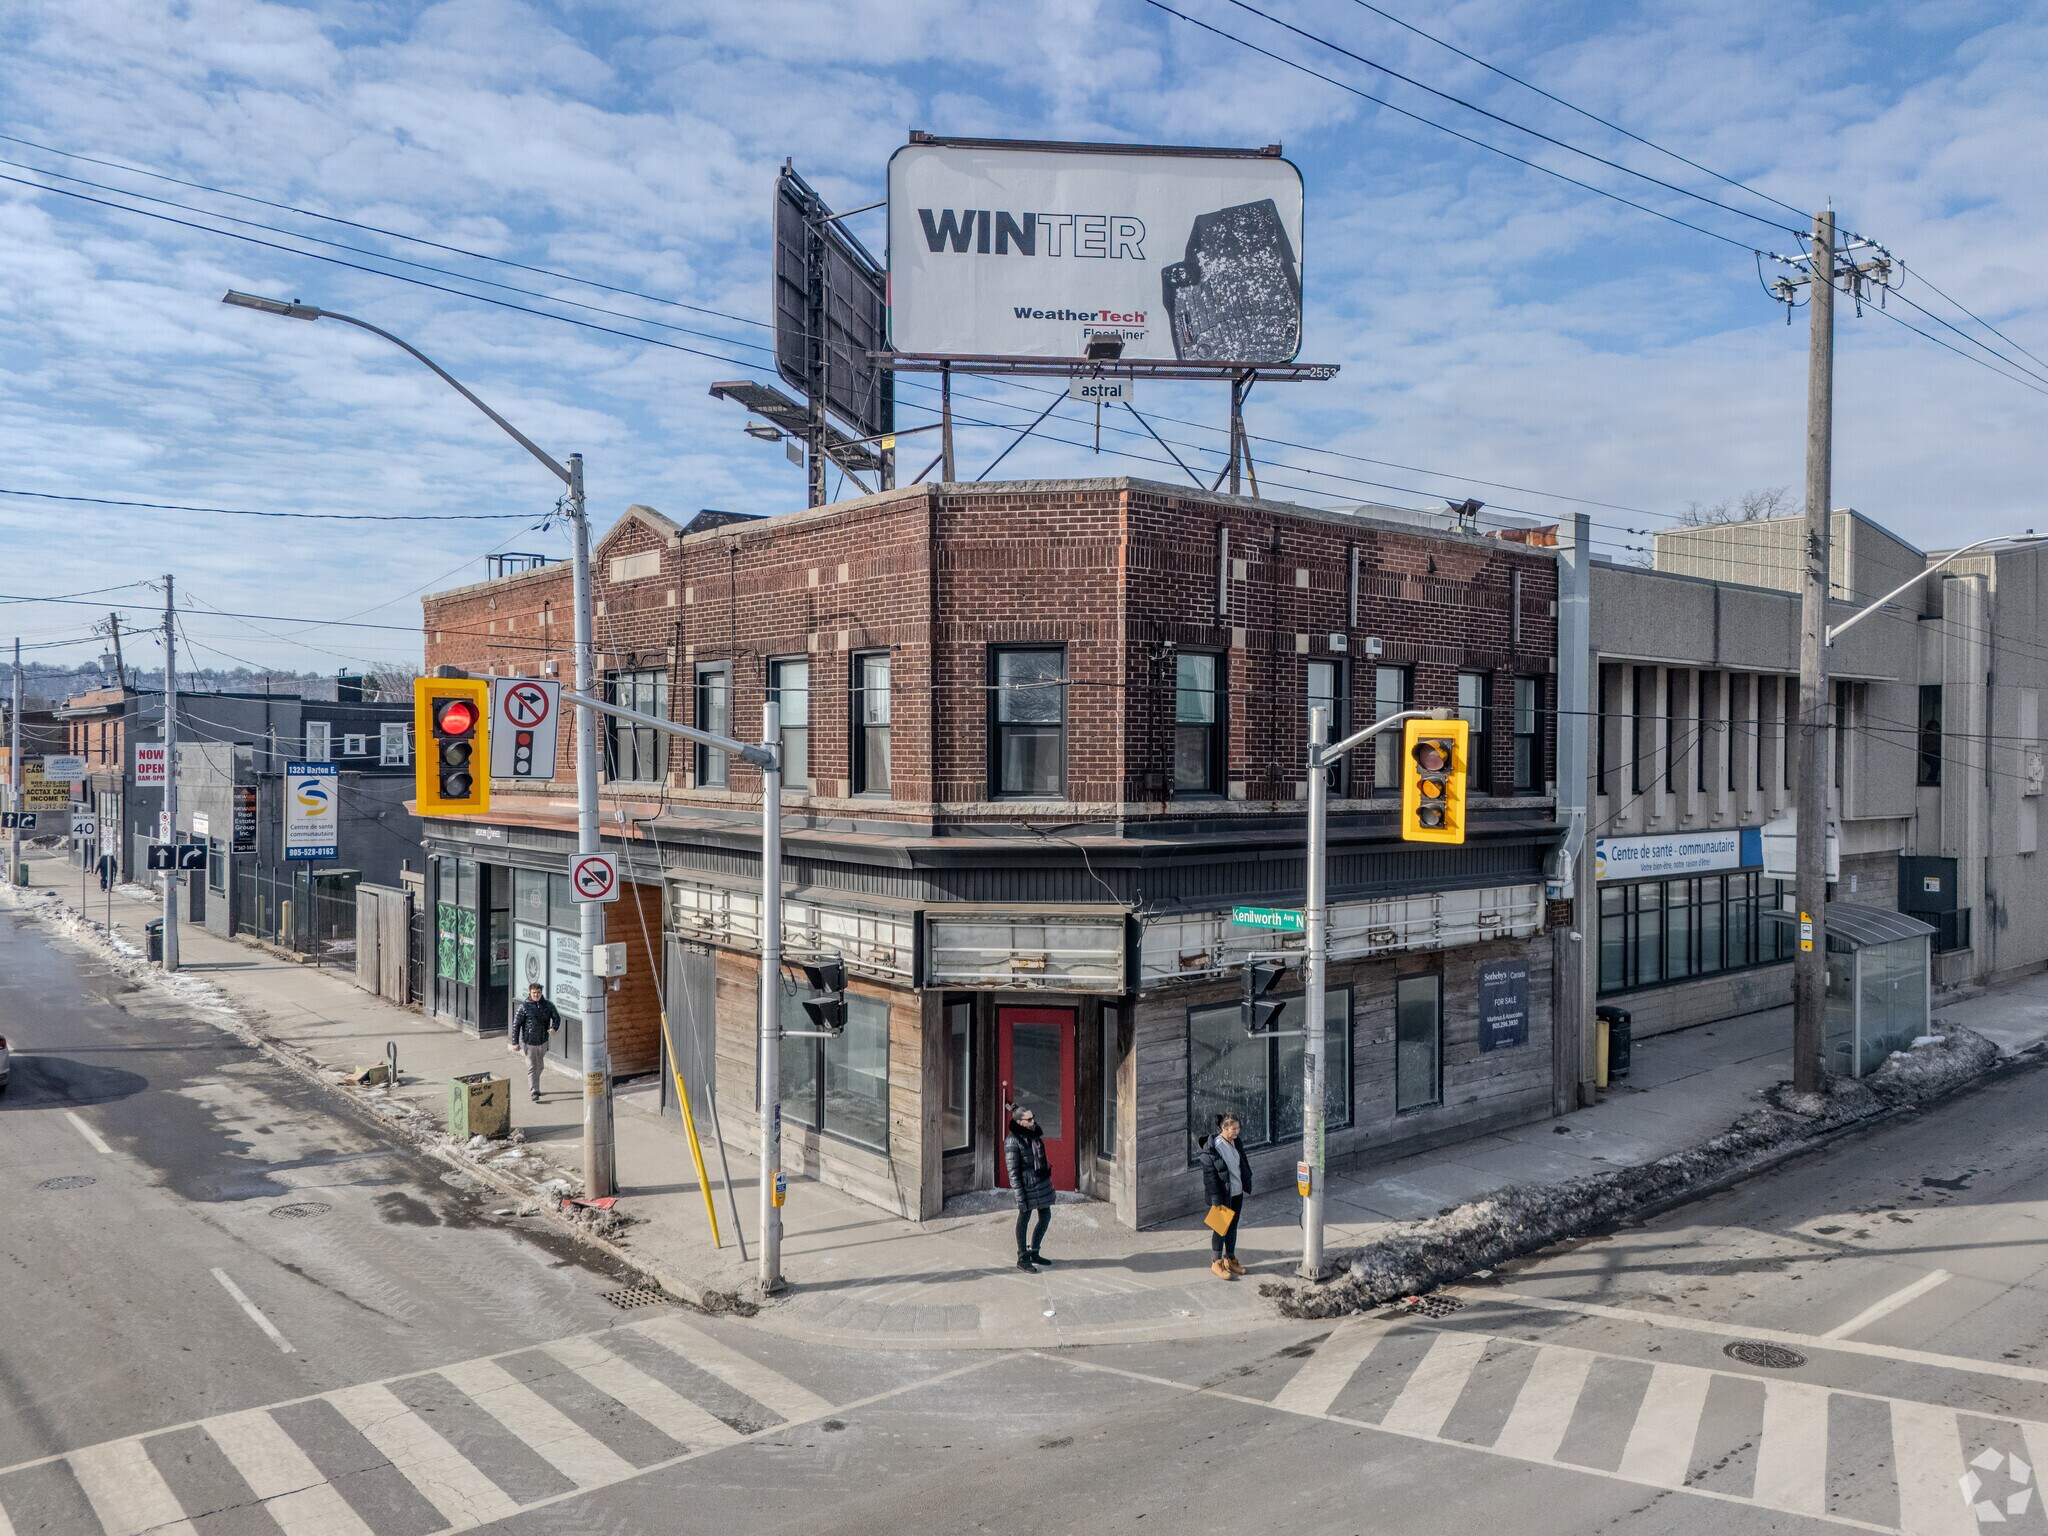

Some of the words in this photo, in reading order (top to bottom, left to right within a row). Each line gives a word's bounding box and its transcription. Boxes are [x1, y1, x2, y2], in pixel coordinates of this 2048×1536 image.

[917, 208, 1146, 260] WINTER
[1310, 366, 1337, 378] 2553
[1081, 384, 1122, 397] astral
[139, 749, 164, 760] NOW
[138, 763, 165, 773] OPEN
[306, 766, 329, 774] Barton
[330, 766, 337, 774] E.
[73, 823, 95, 834] 40
[1611, 845, 1639, 861] Centre
[1640, 843, 1650, 859] de
[1652, 843, 1673, 858] santé
[1678, 837, 1735, 856] communautaire
[1640, 864, 1653, 872] Votre
[1673, 860, 1684, 869] notre
[1685, 859, 1698, 868] raison
[1232, 908, 1282, 926] Kenilworth
[1283, 913, 1294, 922] Ave
[1296, 914, 1304, 928] N
[1509, 971, 1526, 980] Canada
[1494, 998, 1504, 1007] FOR
[1504, 995, 1517, 1005] SALE
